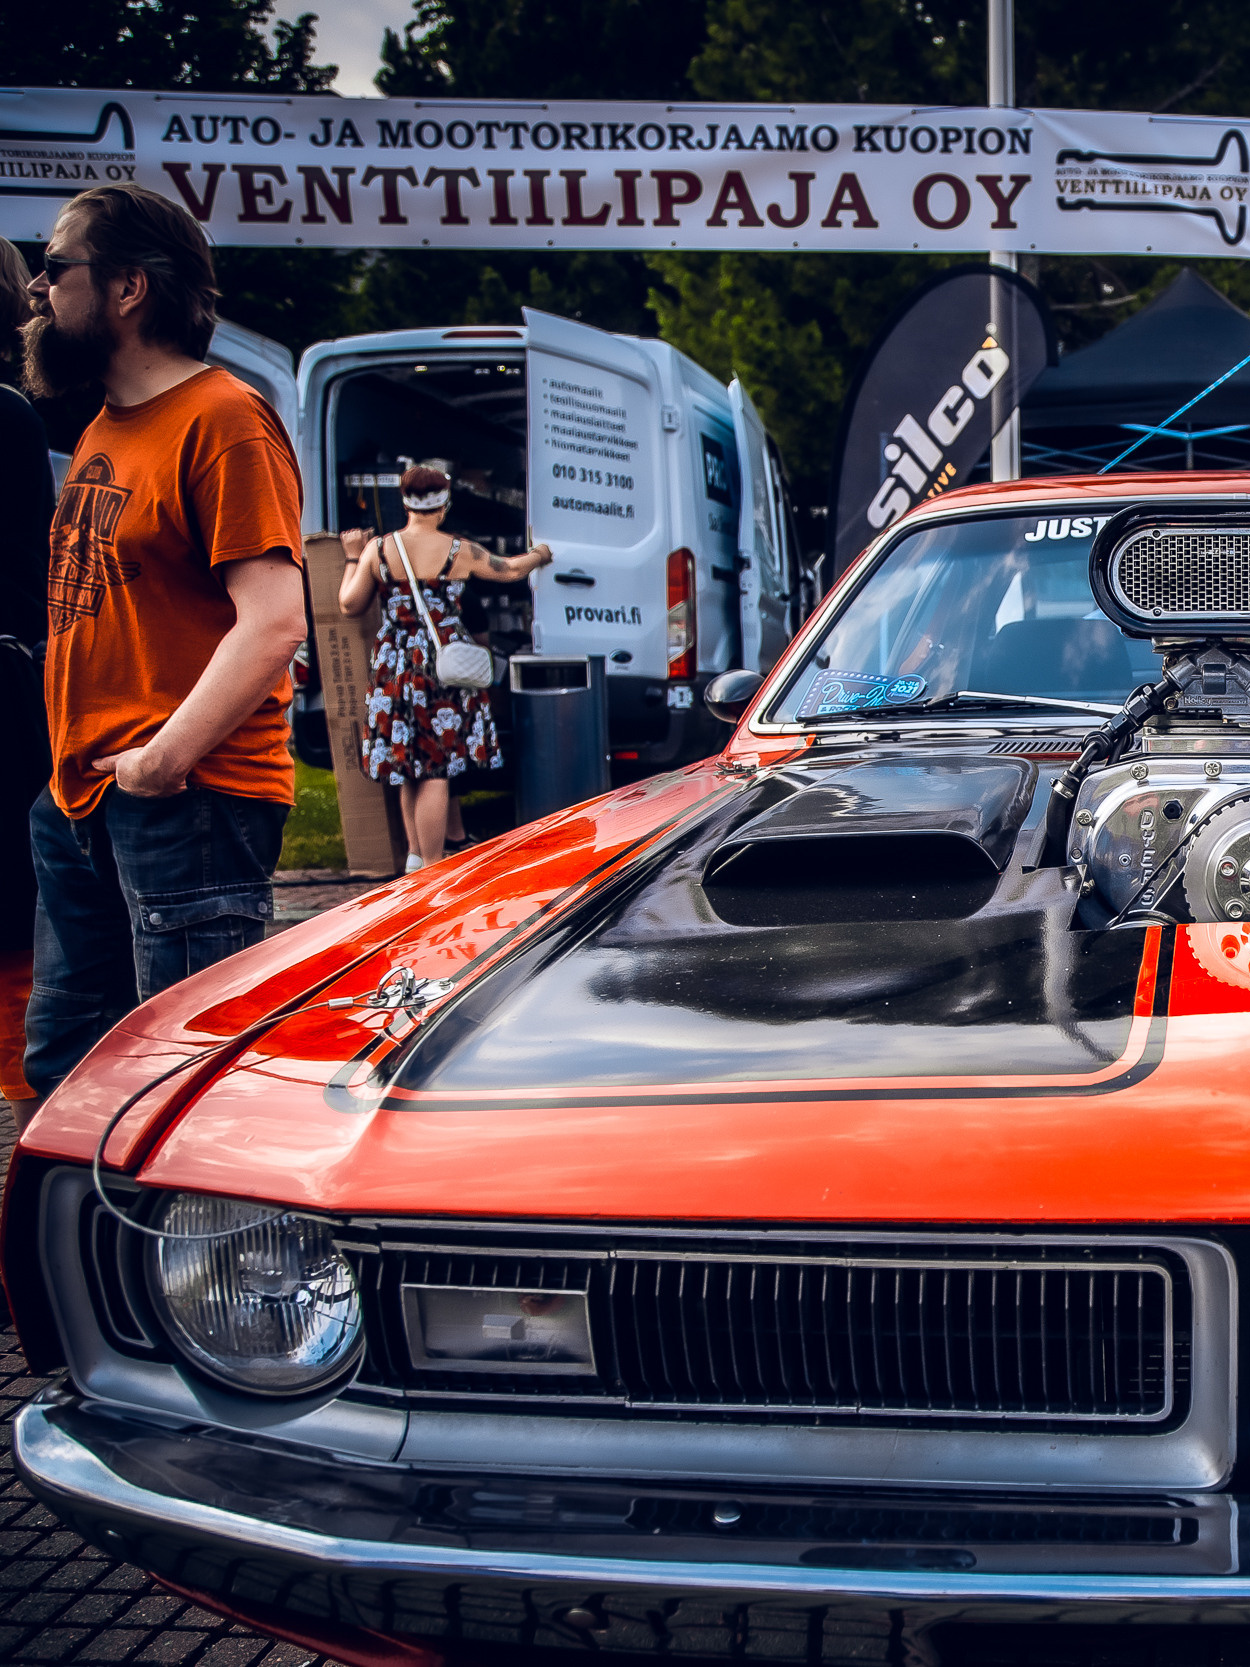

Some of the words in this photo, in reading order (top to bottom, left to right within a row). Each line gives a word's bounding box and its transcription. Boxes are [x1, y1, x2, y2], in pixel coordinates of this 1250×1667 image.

[161, 115, 295, 146] AUTO-
[309, 118, 364, 148] JA
[378, 120, 838, 152] MOOTTORIKORJAAMO
[852, 126, 1033, 154] KUOPION
[105, 165, 136, 181] OY
[162, 162, 879, 229] VENTTIILIPAJA
[912, 173, 1032, 229] OY
[1056, 179, 1212, 200] VENTTIILIPAJA
[1220, 185, 1249, 201] OY
[867, 347, 1010, 529] silco
[552, 463, 576, 481] 010
[579, 467, 603, 485] 315
[605, 472, 635, 491] 3100
[552, 496, 635, 519] automaalit.fi
[1024, 516, 1113, 543] JUST
[565, 605, 642, 626] provari.fi
